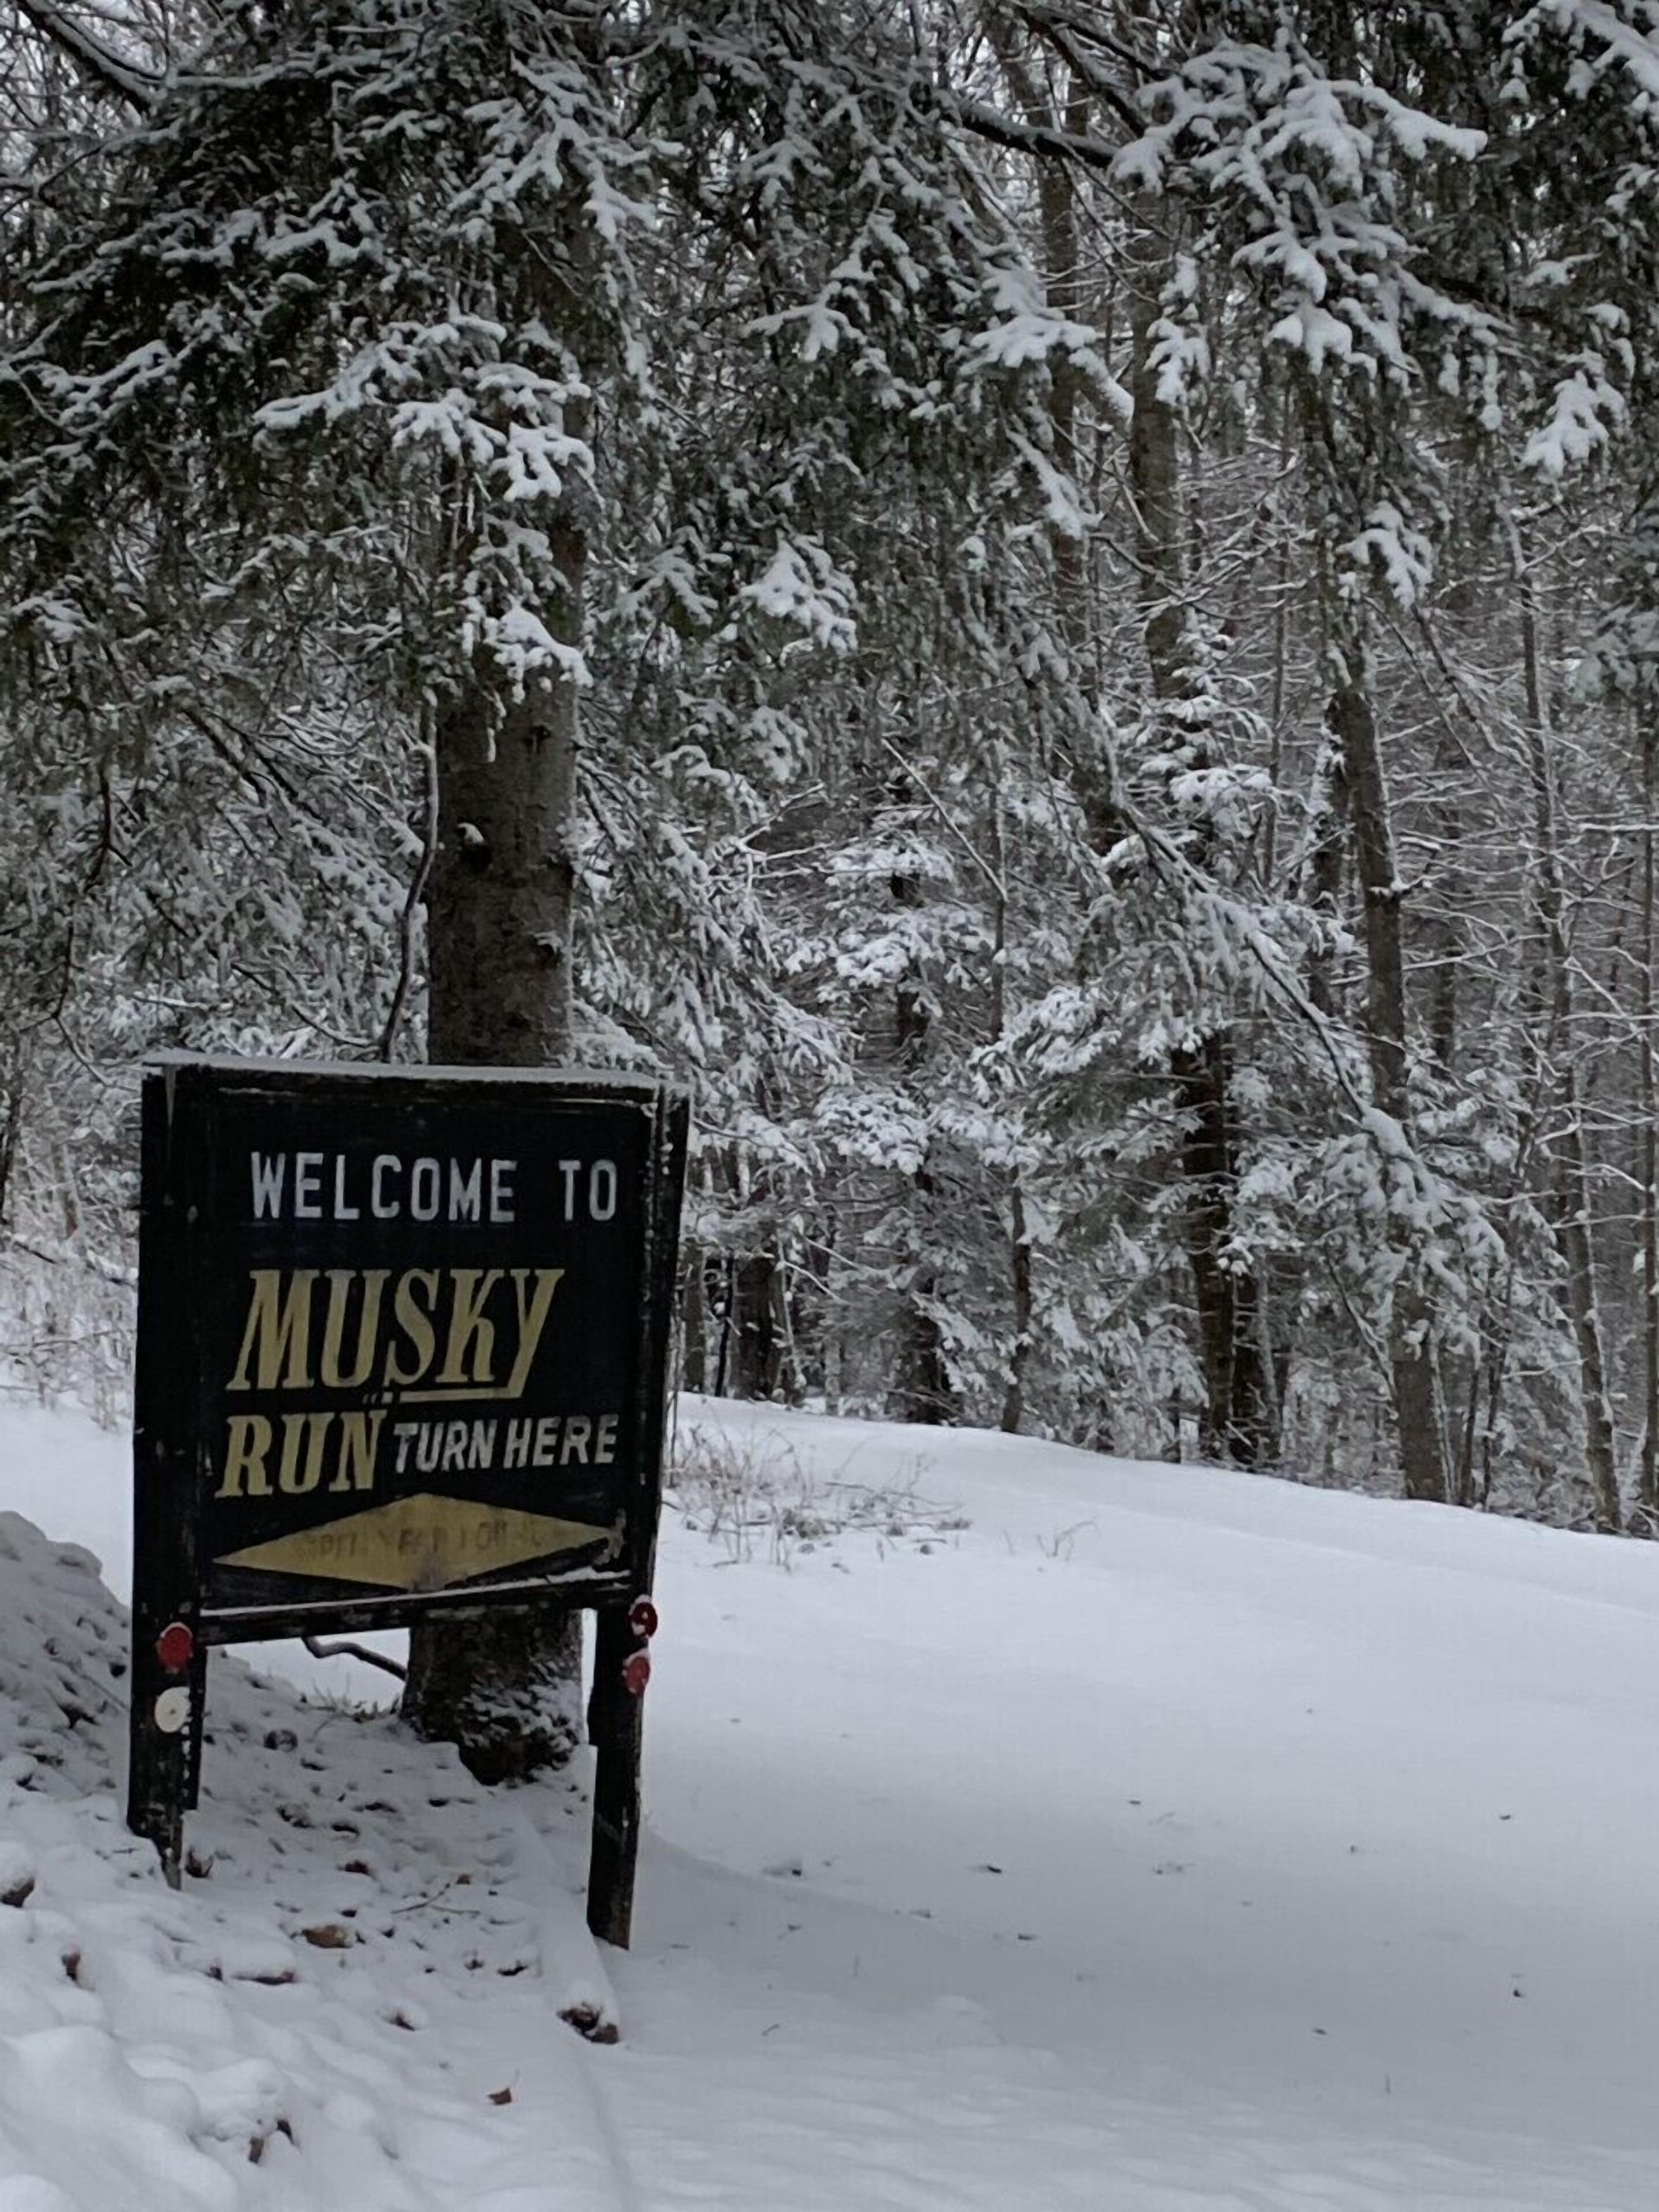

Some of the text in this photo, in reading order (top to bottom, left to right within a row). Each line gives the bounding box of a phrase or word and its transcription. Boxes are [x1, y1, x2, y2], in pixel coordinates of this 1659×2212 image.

[251, 1152, 618, 1224] WELCOME TO
[225, 1268, 565, 1400] MUSKY
[214, 1409, 619, 1499] RUN TURN HERE
